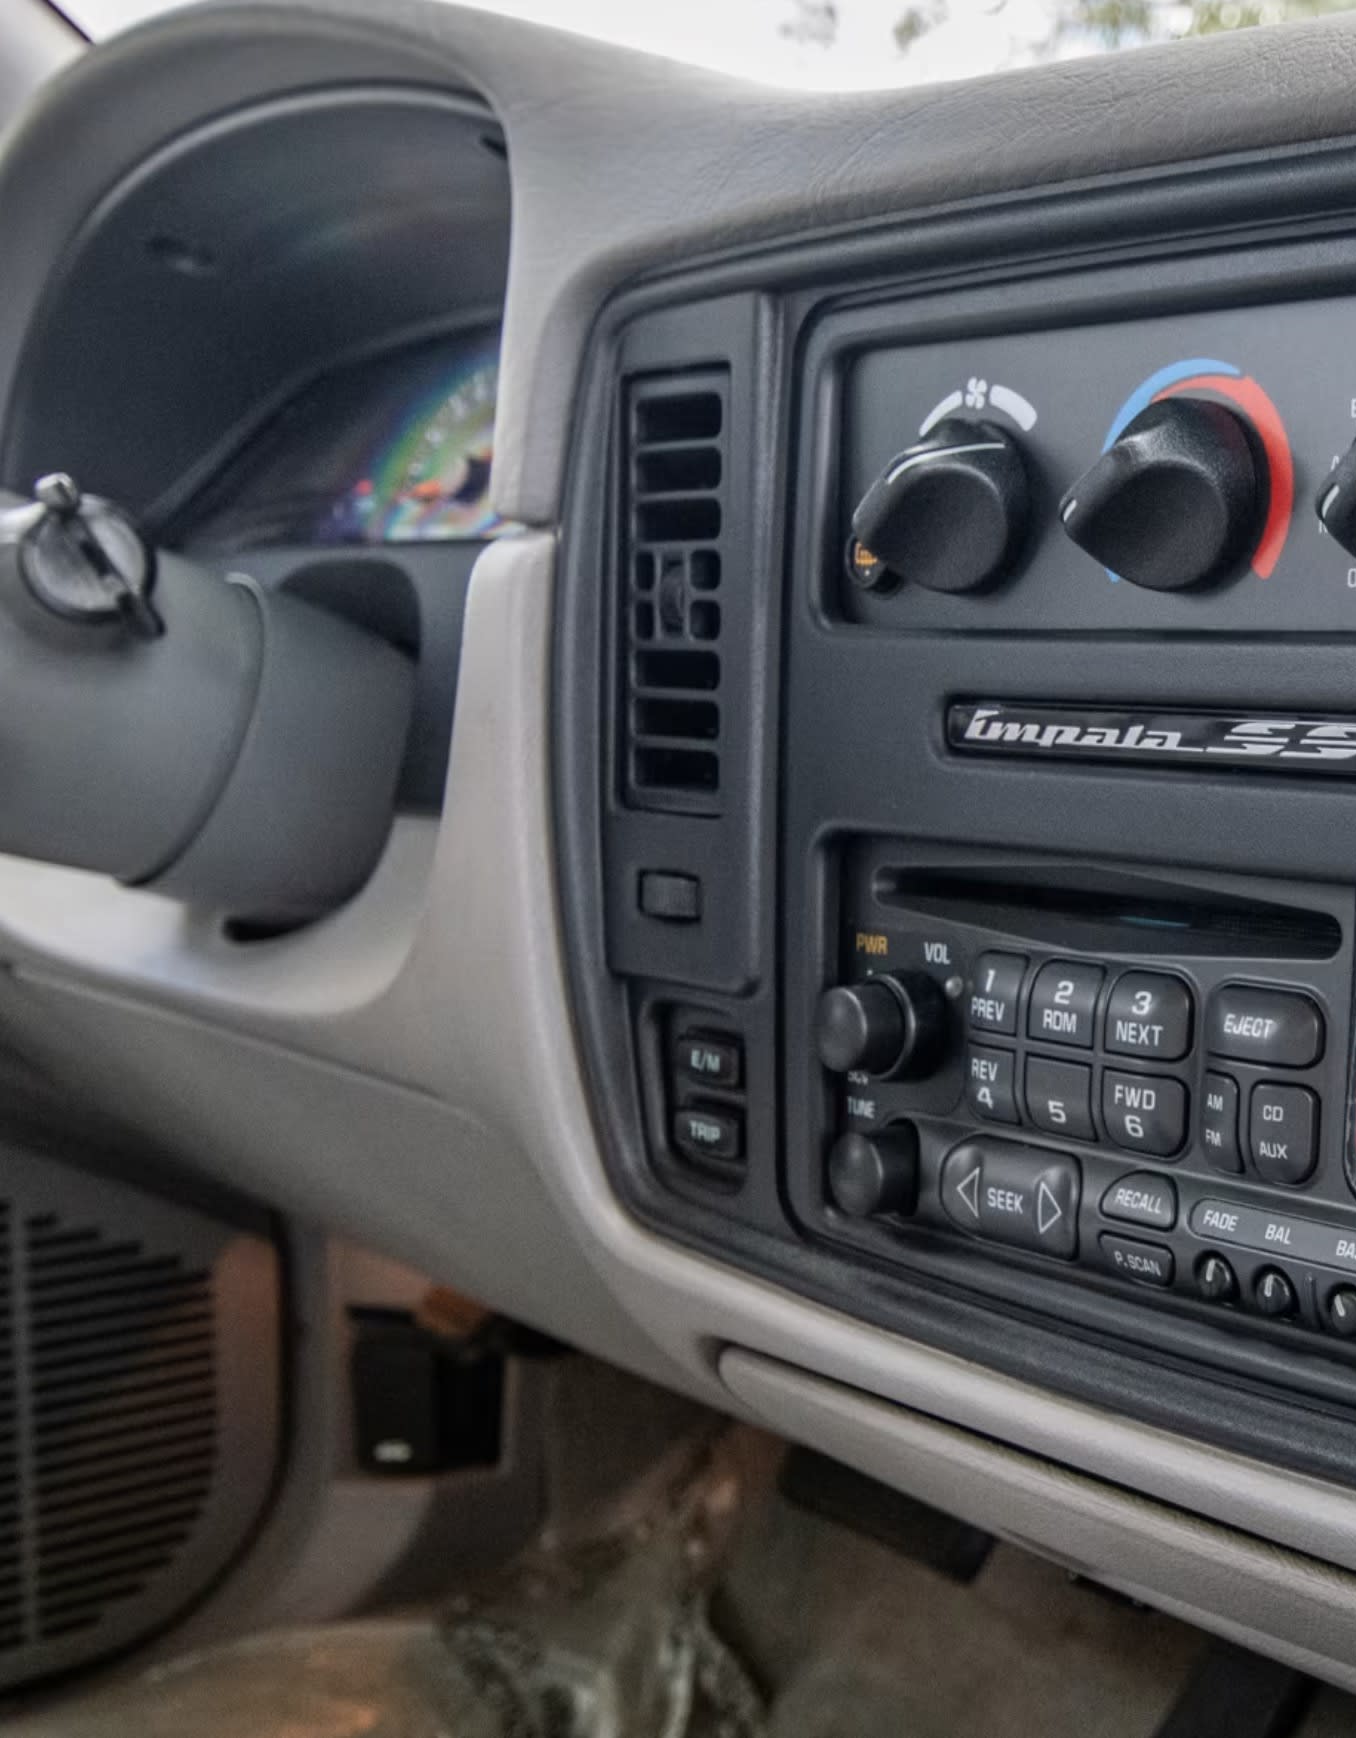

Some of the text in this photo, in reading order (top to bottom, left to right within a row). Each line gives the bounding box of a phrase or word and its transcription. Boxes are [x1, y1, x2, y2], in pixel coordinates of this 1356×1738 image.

[856, 933, 889, 955] PWR
[924, 942, 951, 965] VOL
[985, 969, 996, 993] 1
[1054, 980, 1074, 1005] 2
[971, 997, 1005, 1022] PREV
[1132, 991, 1153, 1015] 3
[1043, 1009, 1077, 1033] RDM
[1116, 1020, 1164, 1046] NEXT
[1223, 1013, 1274, 1040] EJECT
[971, 1058, 998, 1081] REV
[847, 1096, 876, 1119] TUNE
[977, 1086, 993, 1109] 4
[1114, 1085, 1156, 1110] FWD
[1207, 1092, 1223, 1112] AM
[1048, 1099, 1066, 1124] 5
[1263, 1104, 1284, 1122] CD
[689, 1118, 721, 1143] TRIP
[1124, 1114, 1144, 1138] 6
[1205, 1128, 1221, 1147] FM
[1259, 1141, 1288, 1160] AUX
[987, 1186, 1024, 1214] SEEK
[1115, 1188, 1162, 1214] RECALL
[1203, 1209, 1239, 1233] FADE
[1265, 1223, 1292, 1245] BAL
[1113, 1250, 1162, 1277] P.SCAN
